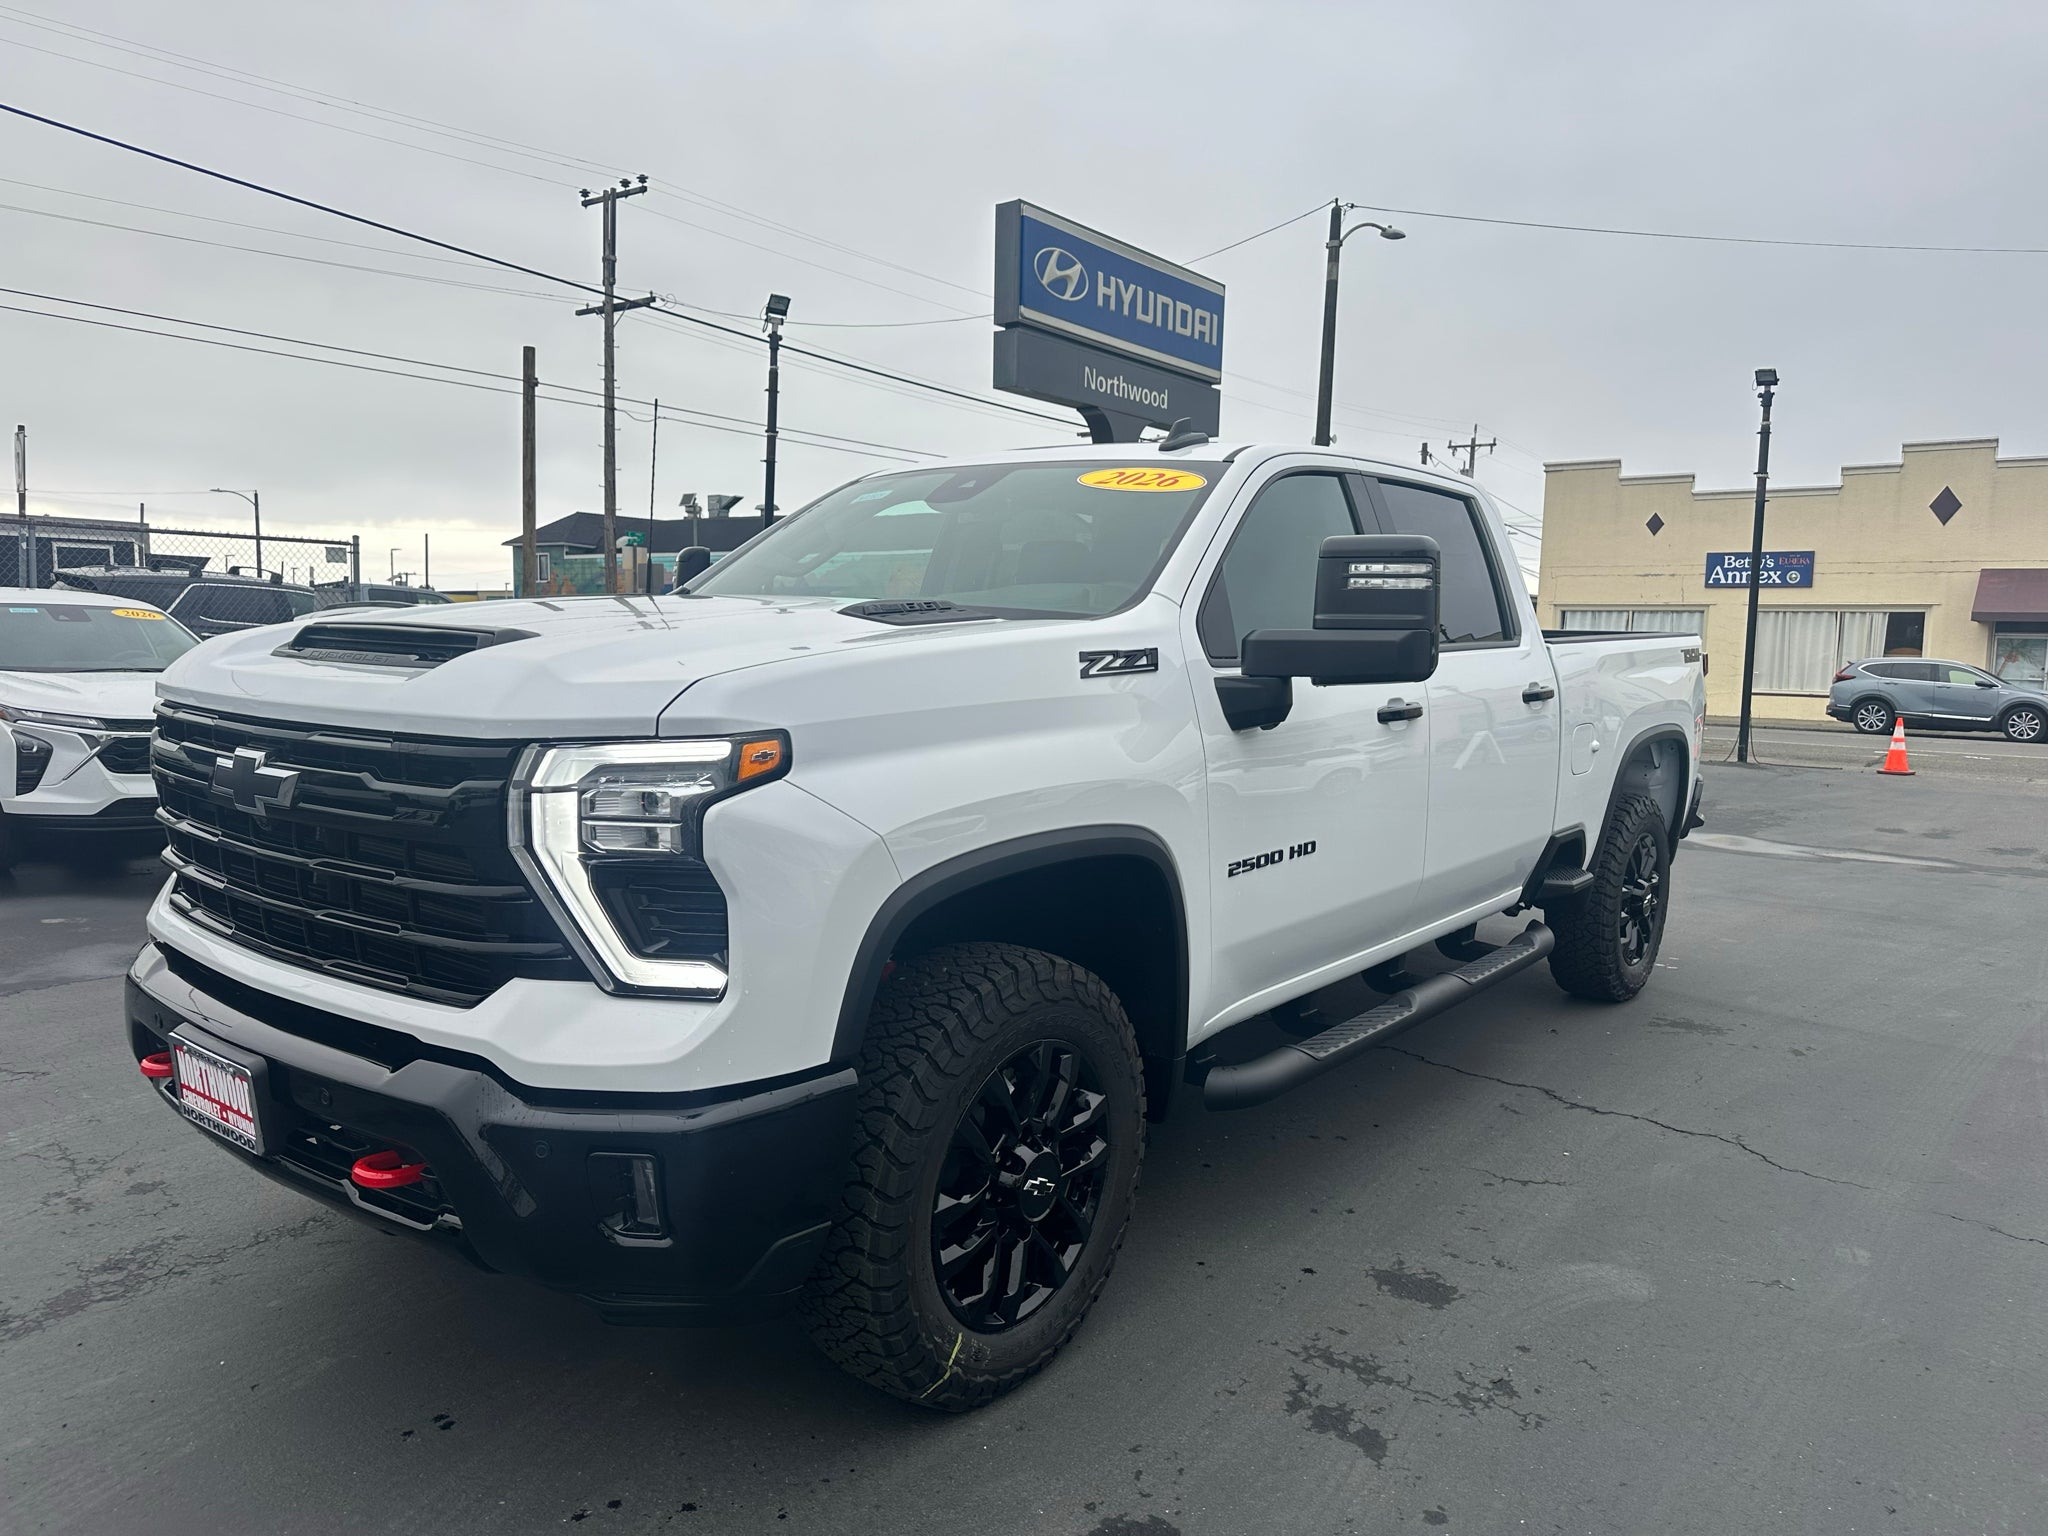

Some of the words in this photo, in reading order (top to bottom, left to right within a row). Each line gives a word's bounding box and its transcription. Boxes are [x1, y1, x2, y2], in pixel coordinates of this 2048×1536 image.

[1097, 271, 1218, 346] HYUNDAI
[1084, 366, 1168, 409] Northwood
[1094, 471, 1185, 487] 2026
[1724, 555, 1775, 569] Bety's
[122, 610, 156, 618] 2026
[308, 650, 396, 664] CHEVROLET
[1079, 648, 1159, 679] Z71
[1228, 849, 1284, 878] 2500
[1289, 841, 1317, 860] HD
[183, 1105, 255, 1150] NORTHWOOD
